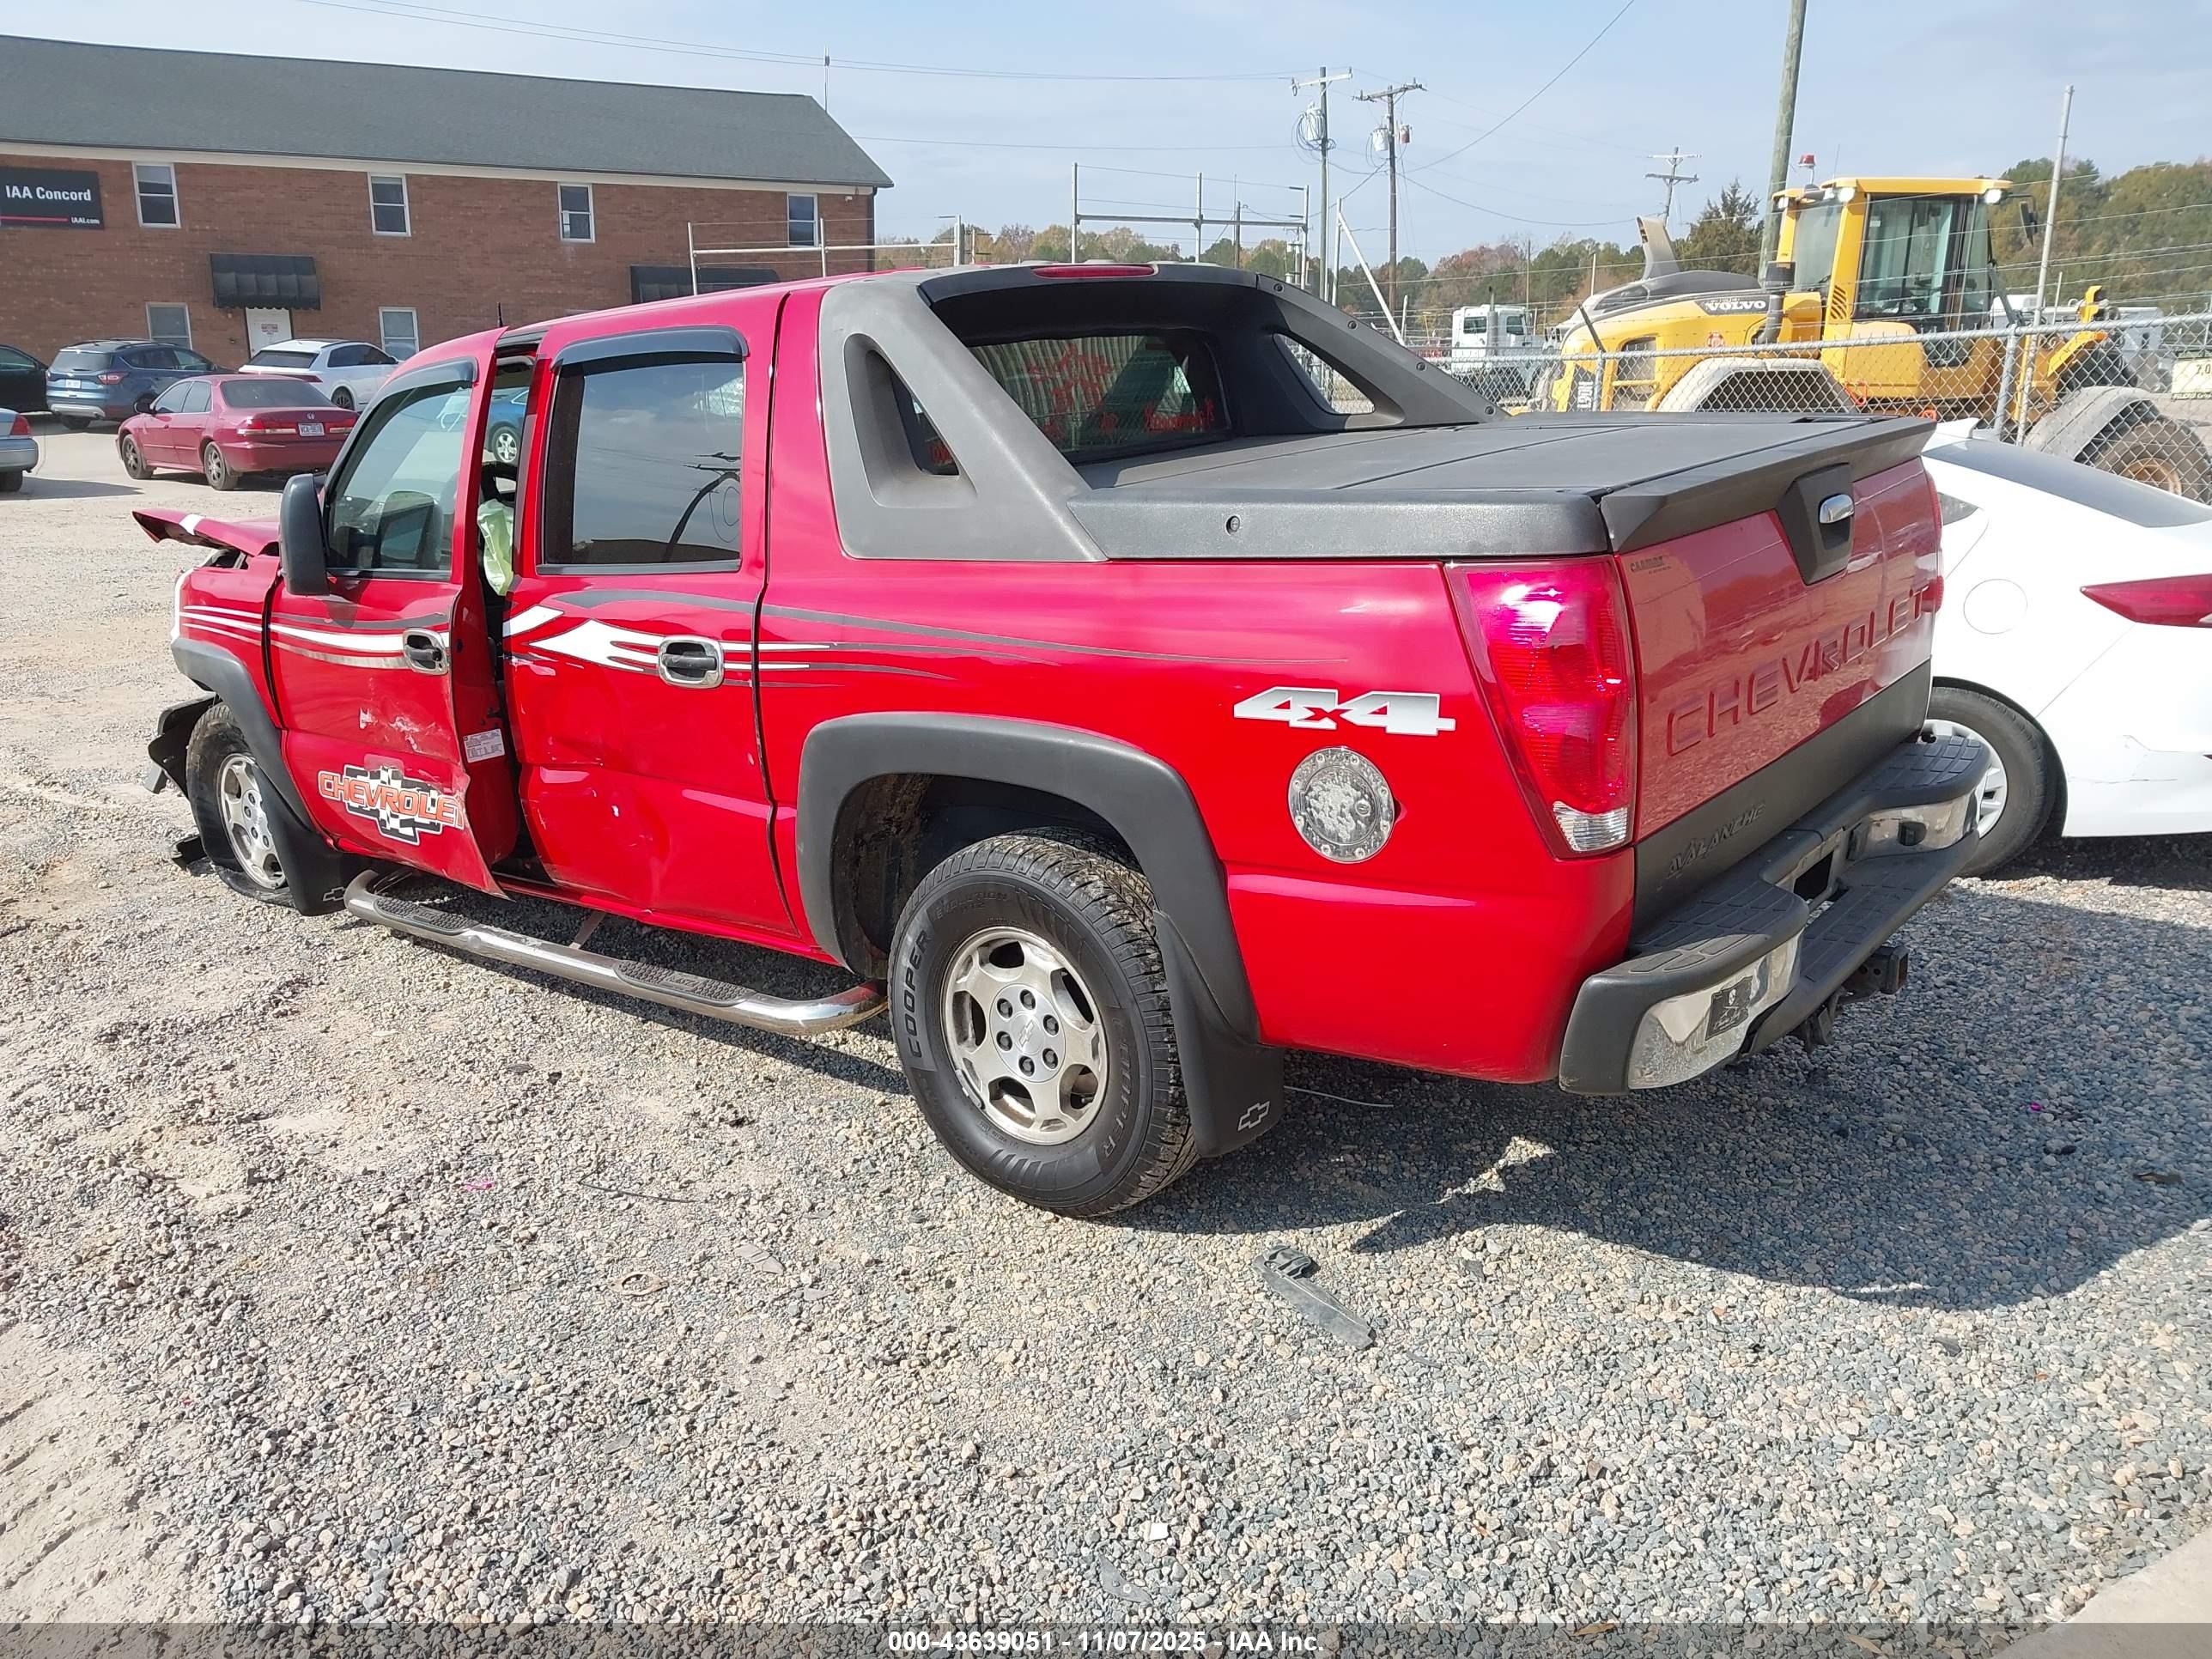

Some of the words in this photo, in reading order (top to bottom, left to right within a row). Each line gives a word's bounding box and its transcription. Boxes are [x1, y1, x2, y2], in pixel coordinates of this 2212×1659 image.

[5, 185, 33, 199] IAA
[36, 186, 92, 201] Concord
[1705, 301, 1766, 311] VOLVO
[1666, 585, 1929, 757] CHEVROLET
[318, 770, 465, 830] CHEVROLET
[908, 929, 935, 1060] COOPER
